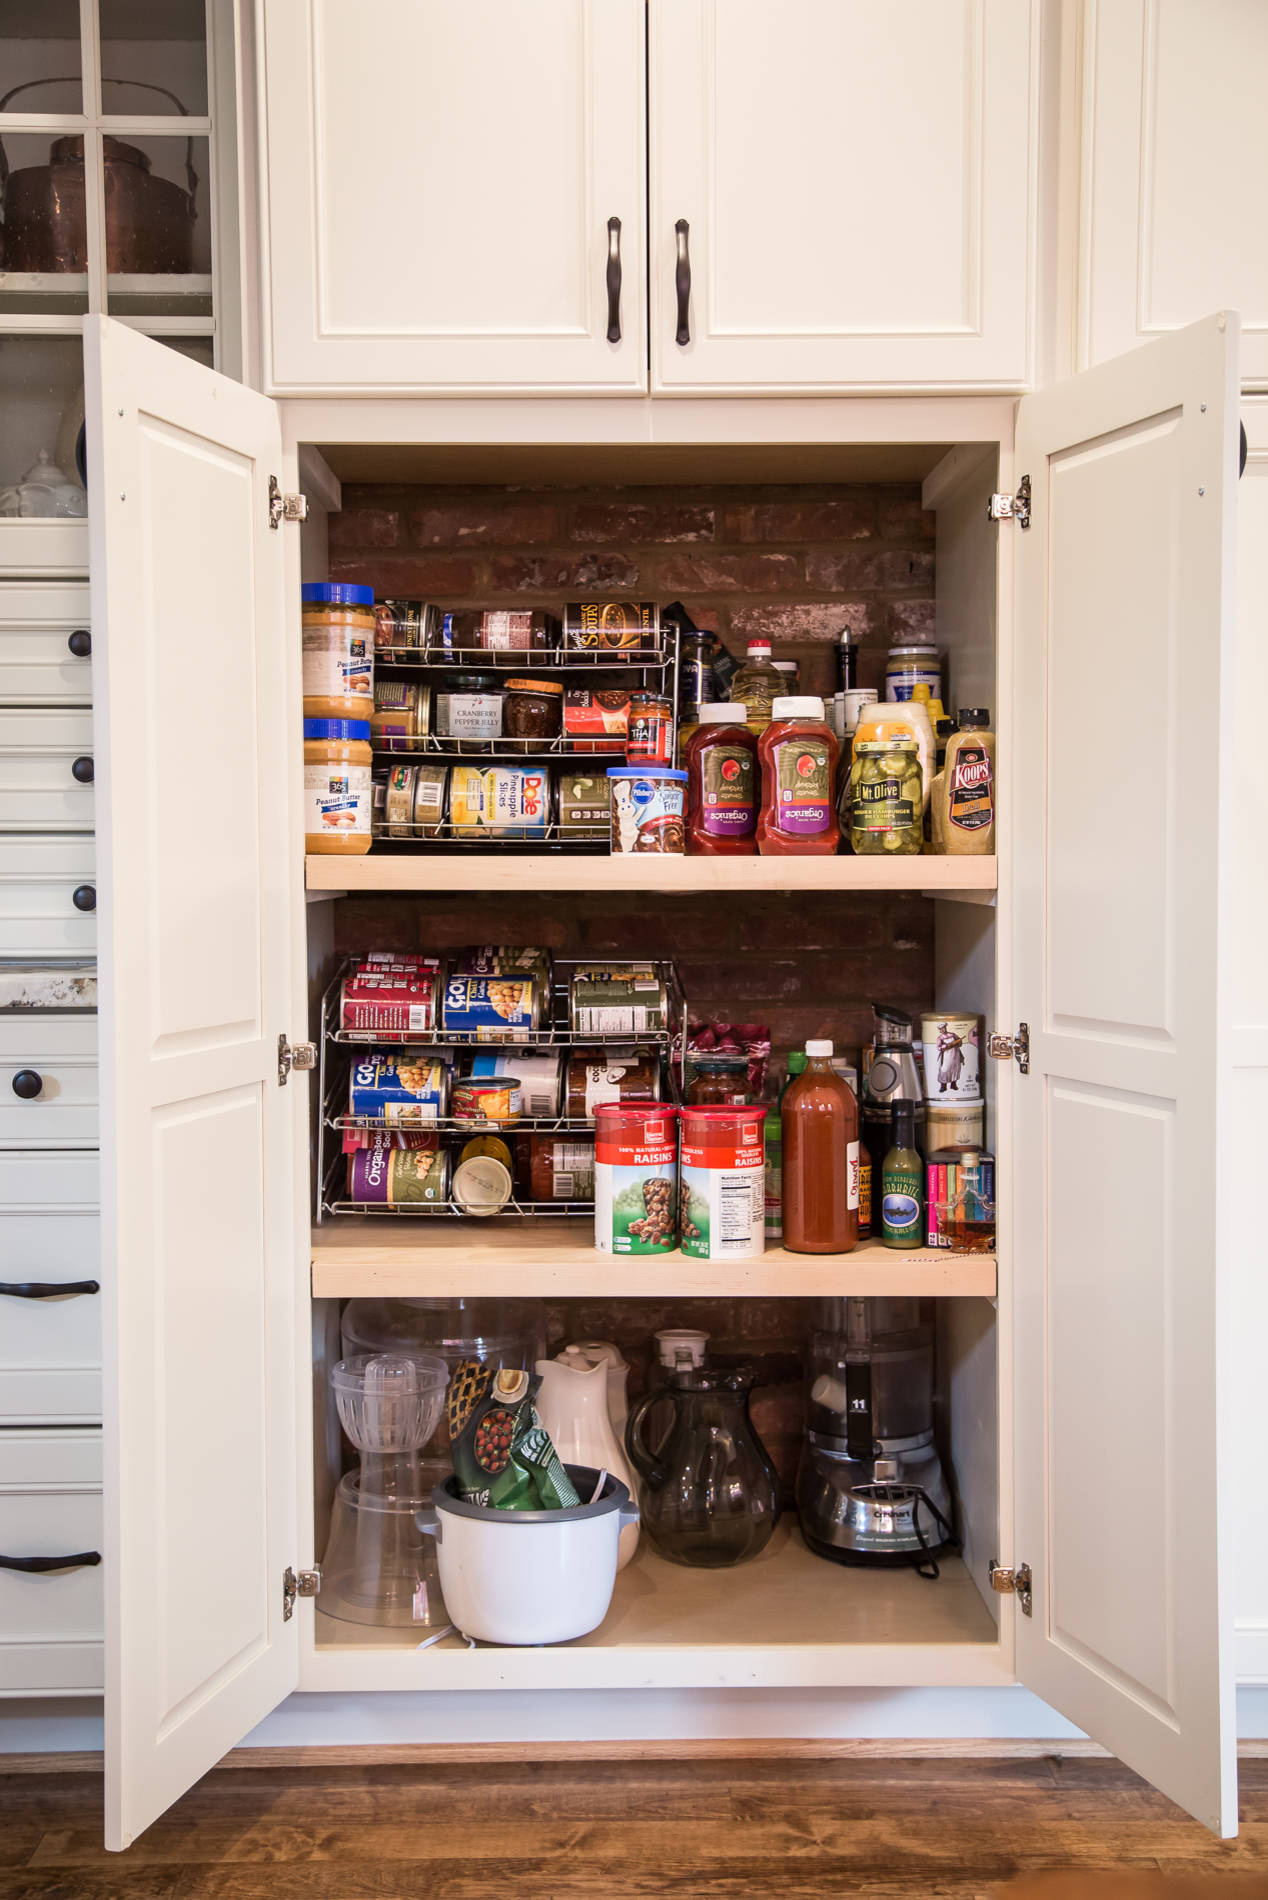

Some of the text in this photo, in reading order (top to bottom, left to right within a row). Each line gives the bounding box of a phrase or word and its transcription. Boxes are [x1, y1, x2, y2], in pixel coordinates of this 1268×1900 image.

[581, 604, 598, 646] SOUPS
[454, 718, 499, 727] PEPPER JELLY
[631, 729, 649, 738] THA
[332, 783, 347, 792] 365
[862, 785, 898, 800] Mt. Olive
[316, 793, 361, 806] Peanut Butter
[500, 782, 508, 807] Slices
[509, 774, 519, 818] Pineapple
[525, 777, 541, 815] Dole
[664, 801, 678, 812] Free
[710, 809, 748, 820] Organics
[785, 808, 823, 819] Organics
[383, 1131, 391, 1148] Sod
[634, 1152, 672, 1164] RAISINS
[735, 1157, 762, 1167] RAISINS
[368, 1149, 385, 1186] Organ
[852, 1399, 865, 1409] 11
